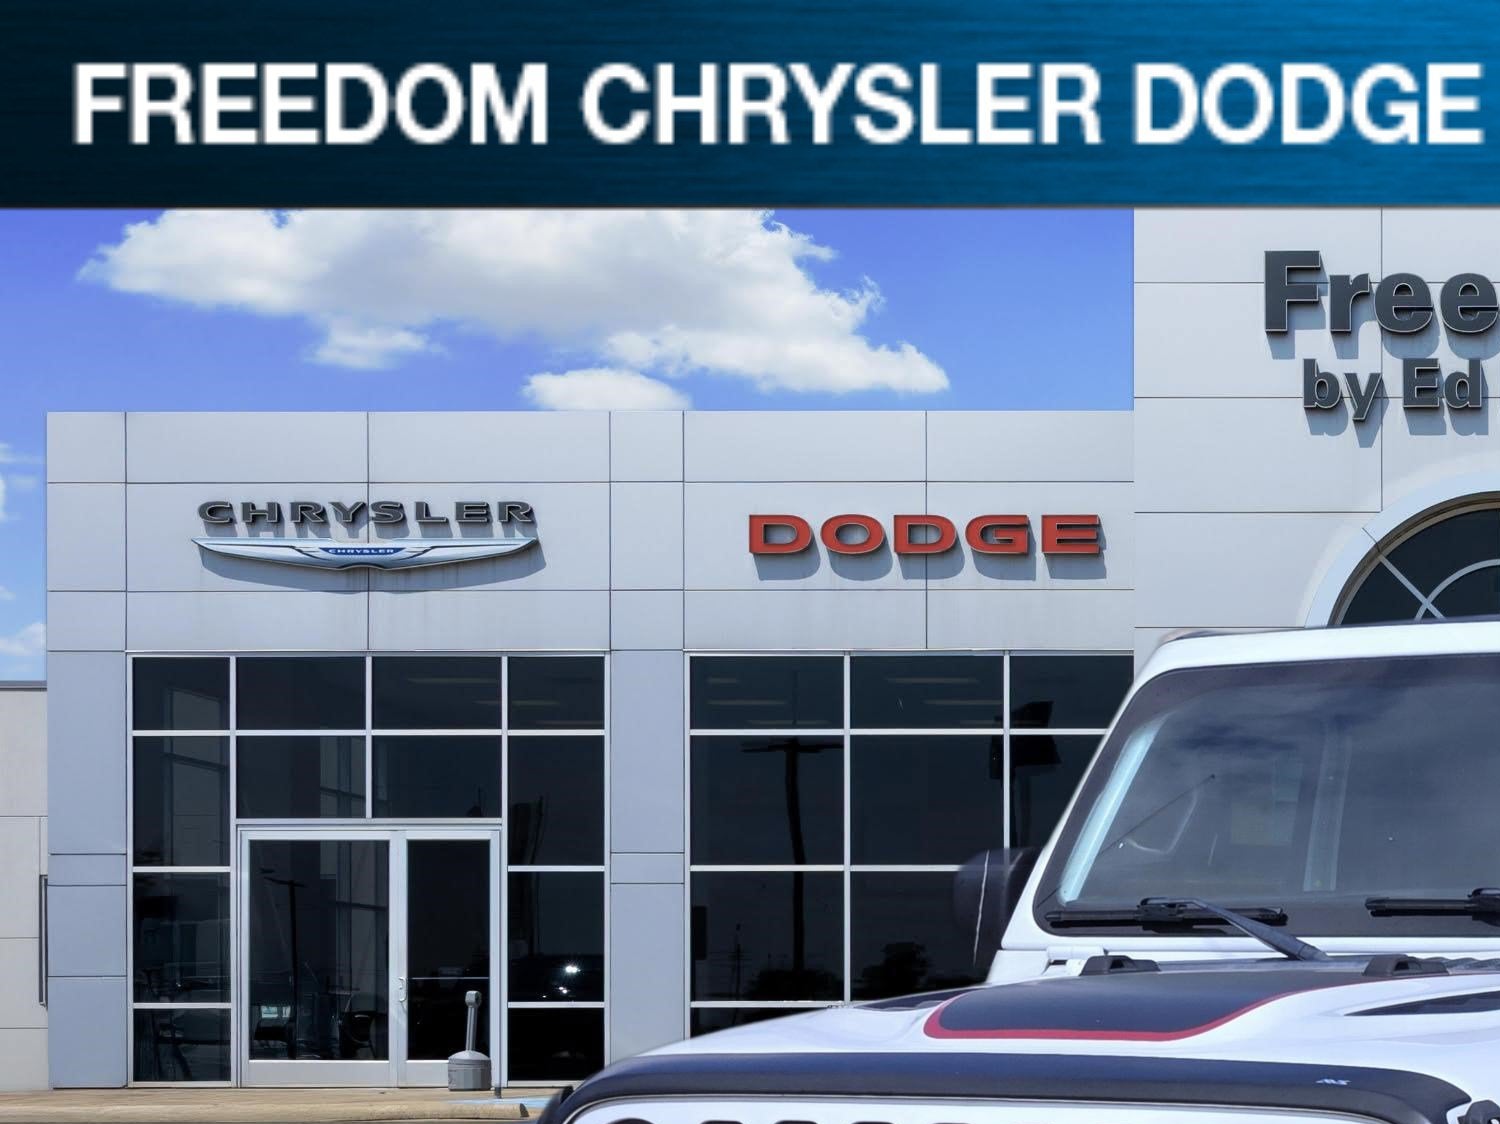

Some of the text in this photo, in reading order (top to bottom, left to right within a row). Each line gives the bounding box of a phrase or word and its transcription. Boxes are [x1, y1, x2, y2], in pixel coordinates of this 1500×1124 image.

[1302, 357, 1383, 422] by
[1401, 357, 1483, 409] Ed
[198, 500, 536, 525] CHRYSLER
[748, 513, 1101, 556] DODGE
